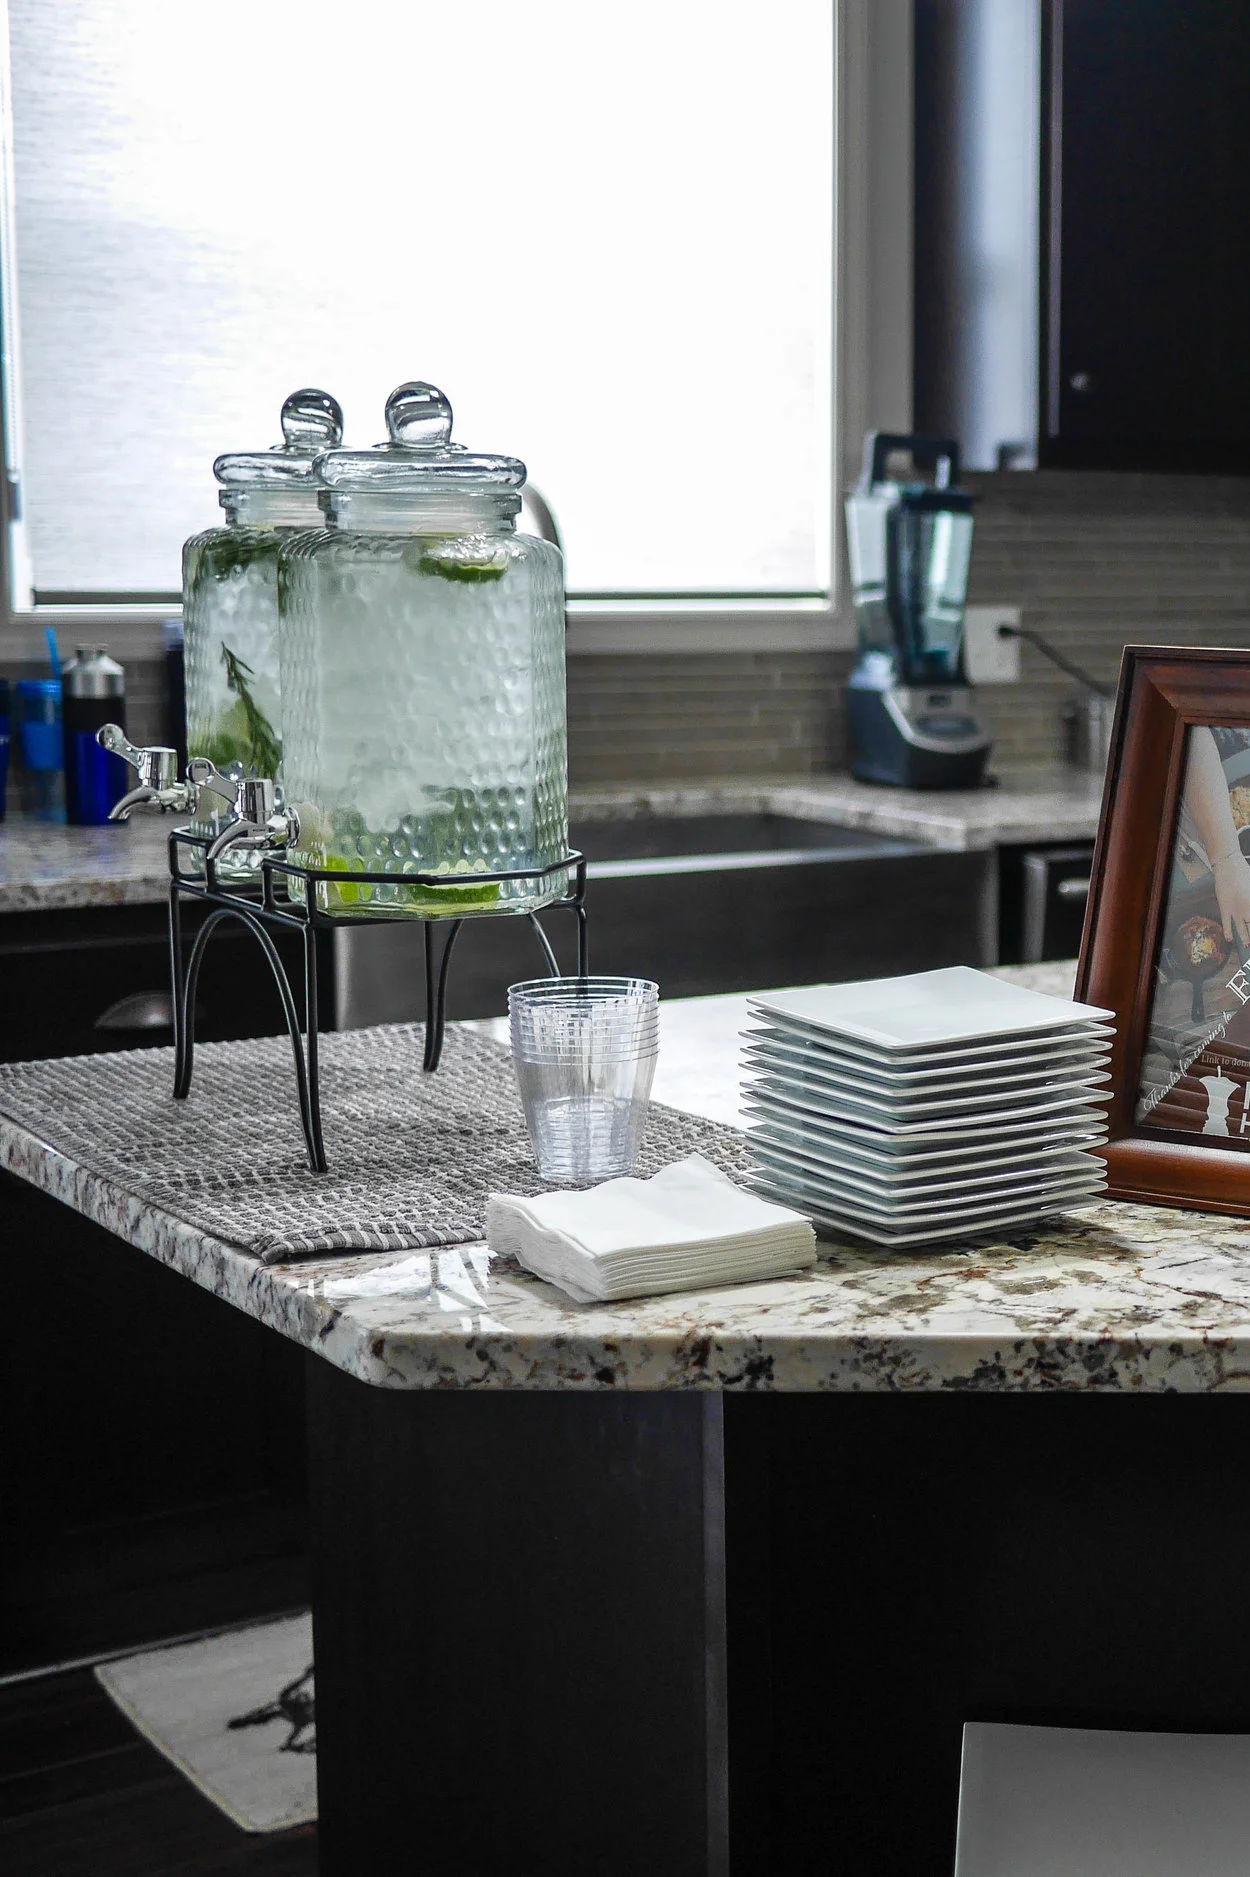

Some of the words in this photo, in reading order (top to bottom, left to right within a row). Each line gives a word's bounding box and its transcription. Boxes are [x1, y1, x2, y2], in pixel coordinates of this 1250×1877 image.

[1143, 1071, 1182, 1112] Thanks
[1178, 1056, 1193, 1078] for
[1193, 1023, 1227, 1058] coming
[1222, 1010, 1233, 1025] to
[1201, 1054, 1220, 1065] Link
[1221, 1056, 1231, 1066] to
